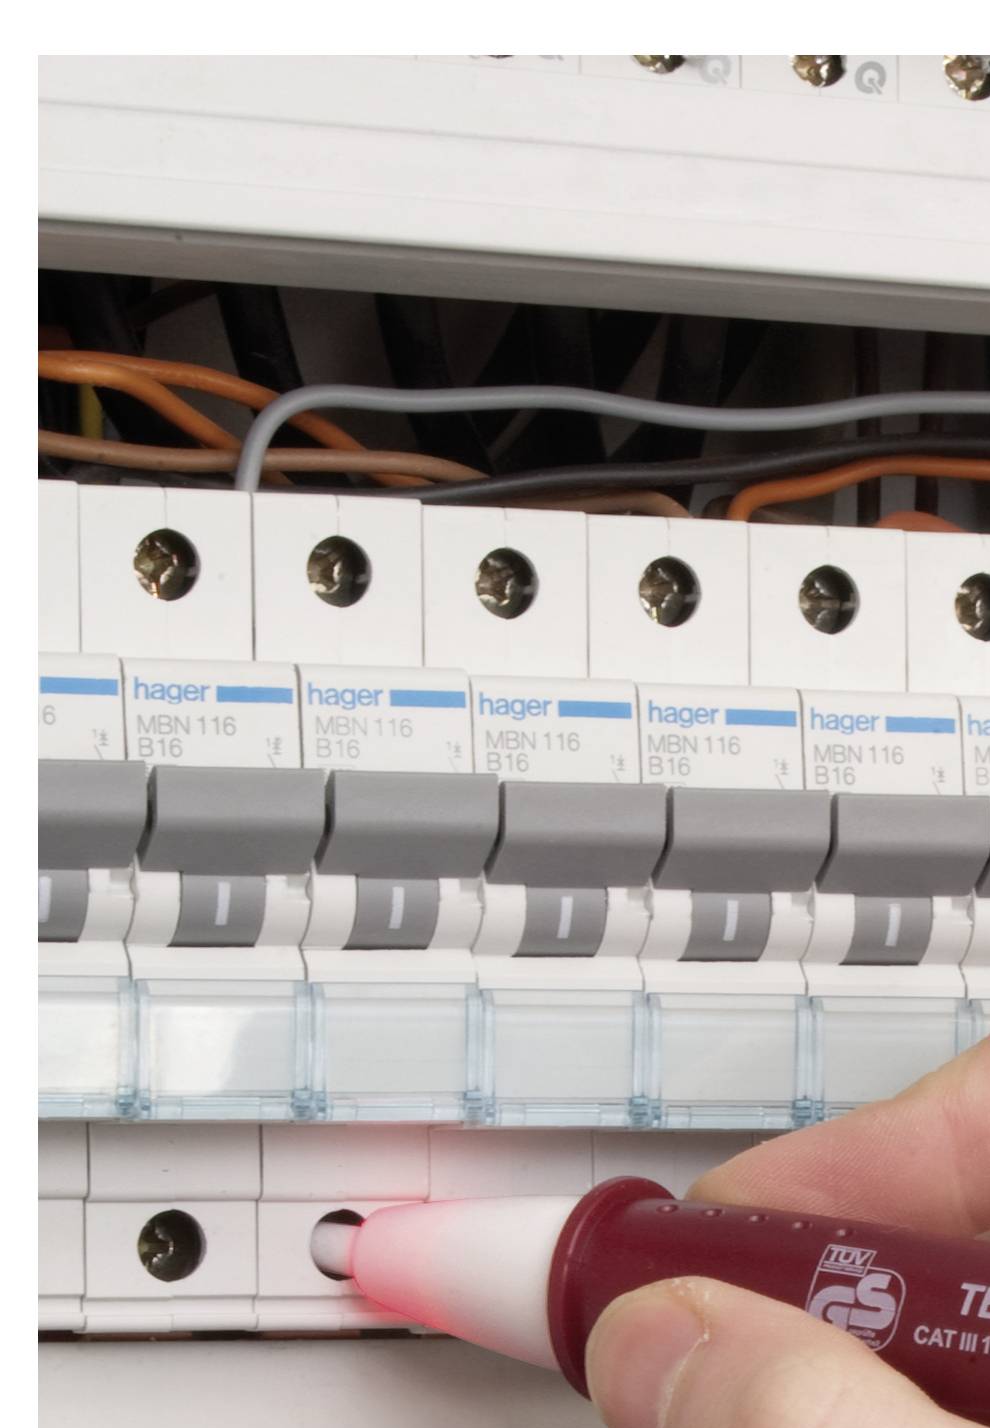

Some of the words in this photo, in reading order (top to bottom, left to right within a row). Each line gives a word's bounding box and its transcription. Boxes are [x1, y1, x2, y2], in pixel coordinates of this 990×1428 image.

[134, 677, 210, 704] hager
[308, 682, 383, 710] hager
[479, 693, 552, 720] hager
[649, 700, 719, 728] hager
[137, 715, 190, 735] MBN
[198, 717, 236, 736] 116
[315, 716, 368, 736] MBN
[375, 718, 413, 738] 116
[810, 707, 880, 734] hager
[139, 738, 183, 758] B16
[317, 739, 360, 758] B16
[486, 731, 535, 750] MBN
[545, 733, 580, 752] 116
[648, 735, 698, 754] MBN
[705, 737, 740, 756] 116
[487, 754, 529, 772] B16
[814, 745, 862, 764] MBN
[869, 747, 904, 765] 116
[649, 758, 690, 776] B16
[815, 766, 856, 785] B16
[913, 1324, 958, 1350] CAT
[959, 1331, 978, 1352] III
